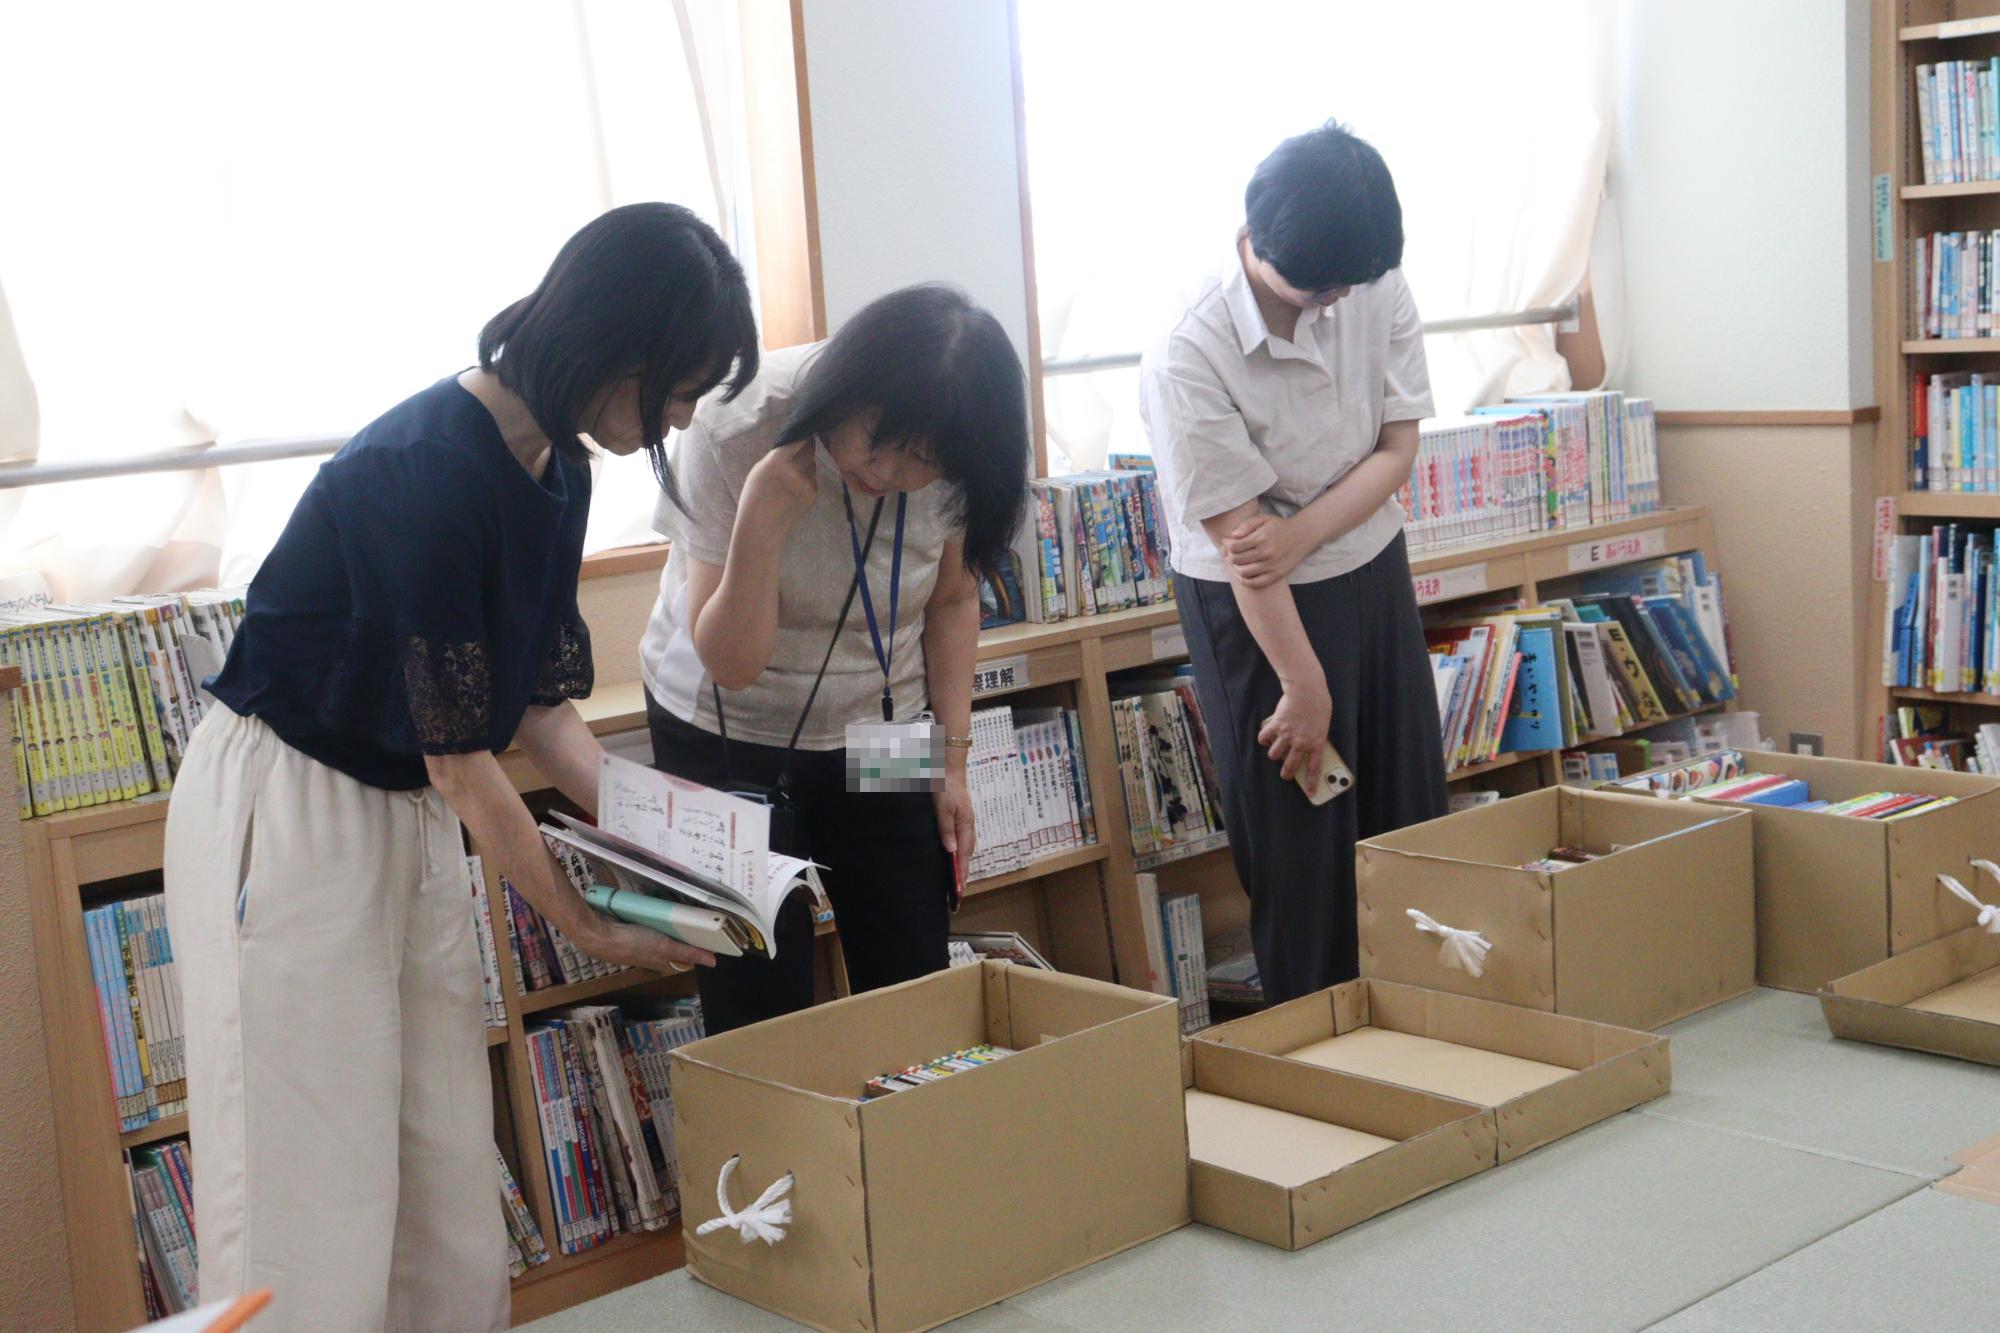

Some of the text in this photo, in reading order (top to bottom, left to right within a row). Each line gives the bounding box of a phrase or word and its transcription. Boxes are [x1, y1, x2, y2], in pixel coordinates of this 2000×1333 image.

[1591, 538, 1642, 562] E あいうえお
